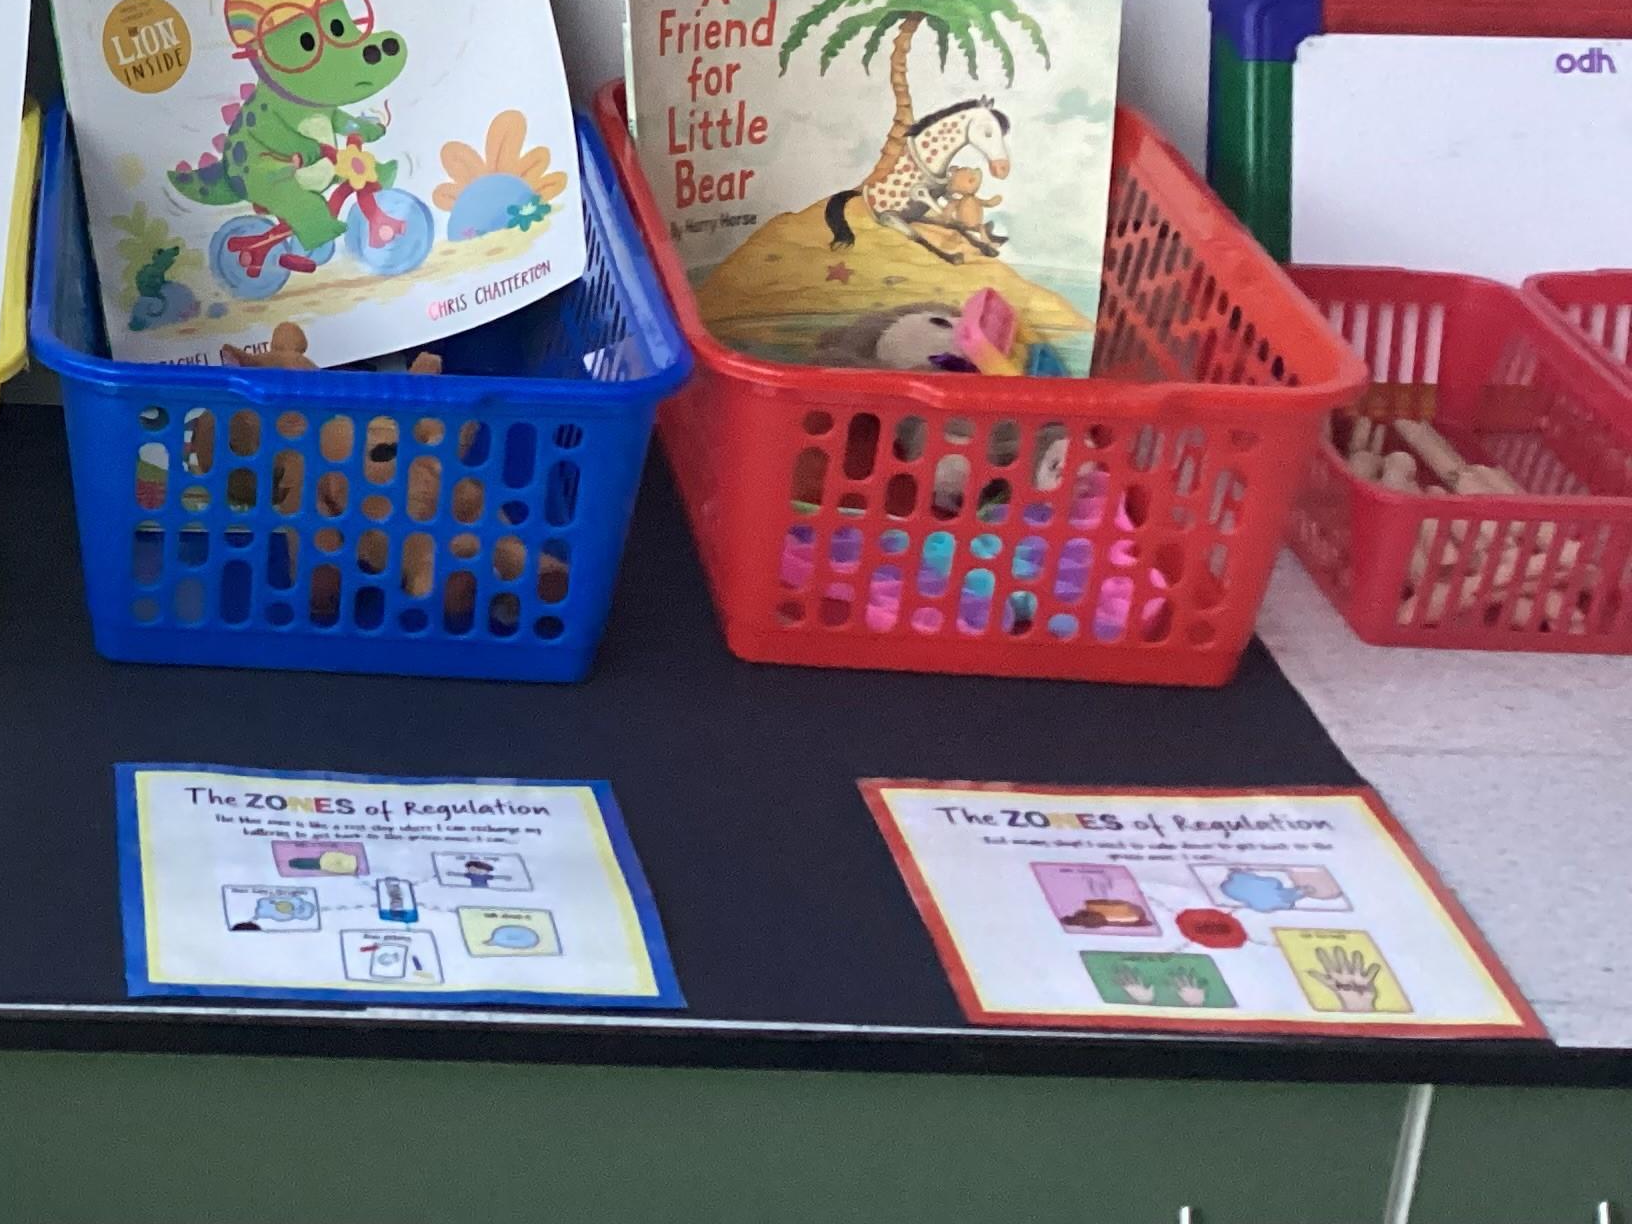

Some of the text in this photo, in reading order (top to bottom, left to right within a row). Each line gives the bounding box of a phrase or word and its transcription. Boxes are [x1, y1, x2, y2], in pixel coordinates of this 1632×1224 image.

[111, 18, 181, 65] LION
[659, 0, 778, 56] Friend
[124, 48, 185, 86] INSIDE
[687, 56, 742, 103] for
[668, 101, 769, 156] Little
[675, 160, 755, 209] Bear
[428, 260, 551, 321] CHRIS CHATTERTON
[184, 787, 550, 822] The ZONES of Regulation
[934, 806, 1334, 838] The ZONES of Regulation
